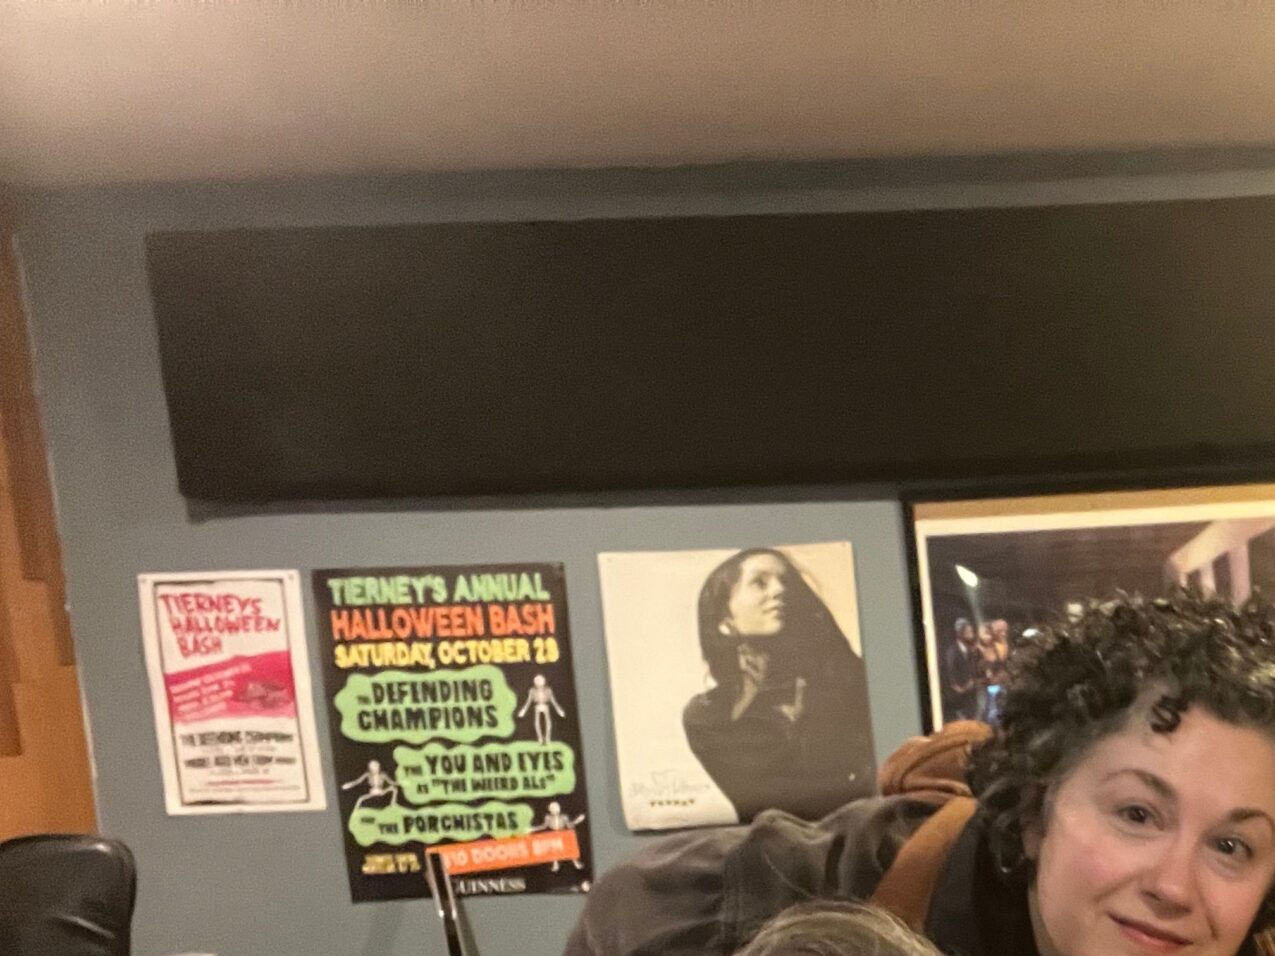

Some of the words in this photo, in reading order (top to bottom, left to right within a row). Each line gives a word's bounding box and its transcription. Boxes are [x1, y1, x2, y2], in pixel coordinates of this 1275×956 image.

[327, 575, 448, 606] TIERNEY'S
[454, 572, 550, 601] ANNUAL
[330, 604, 485, 640] HALLOWEEN
[488, 603, 557, 635] BASH
[334, 641, 436, 669] SATURDAY,
[437, 638, 531, 666] OCTOBER
[372, 678, 494, 705] DEFENDING
[358, 705, 499, 731] CHAMPIONS
[425, 754, 467, 776] YOU
[473, 752, 513, 773] AND
[518, 750, 565, 772] EYES
[472, 777, 519, 792] WEIRD
[403, 812, 519, 834] PORCHISTAS
